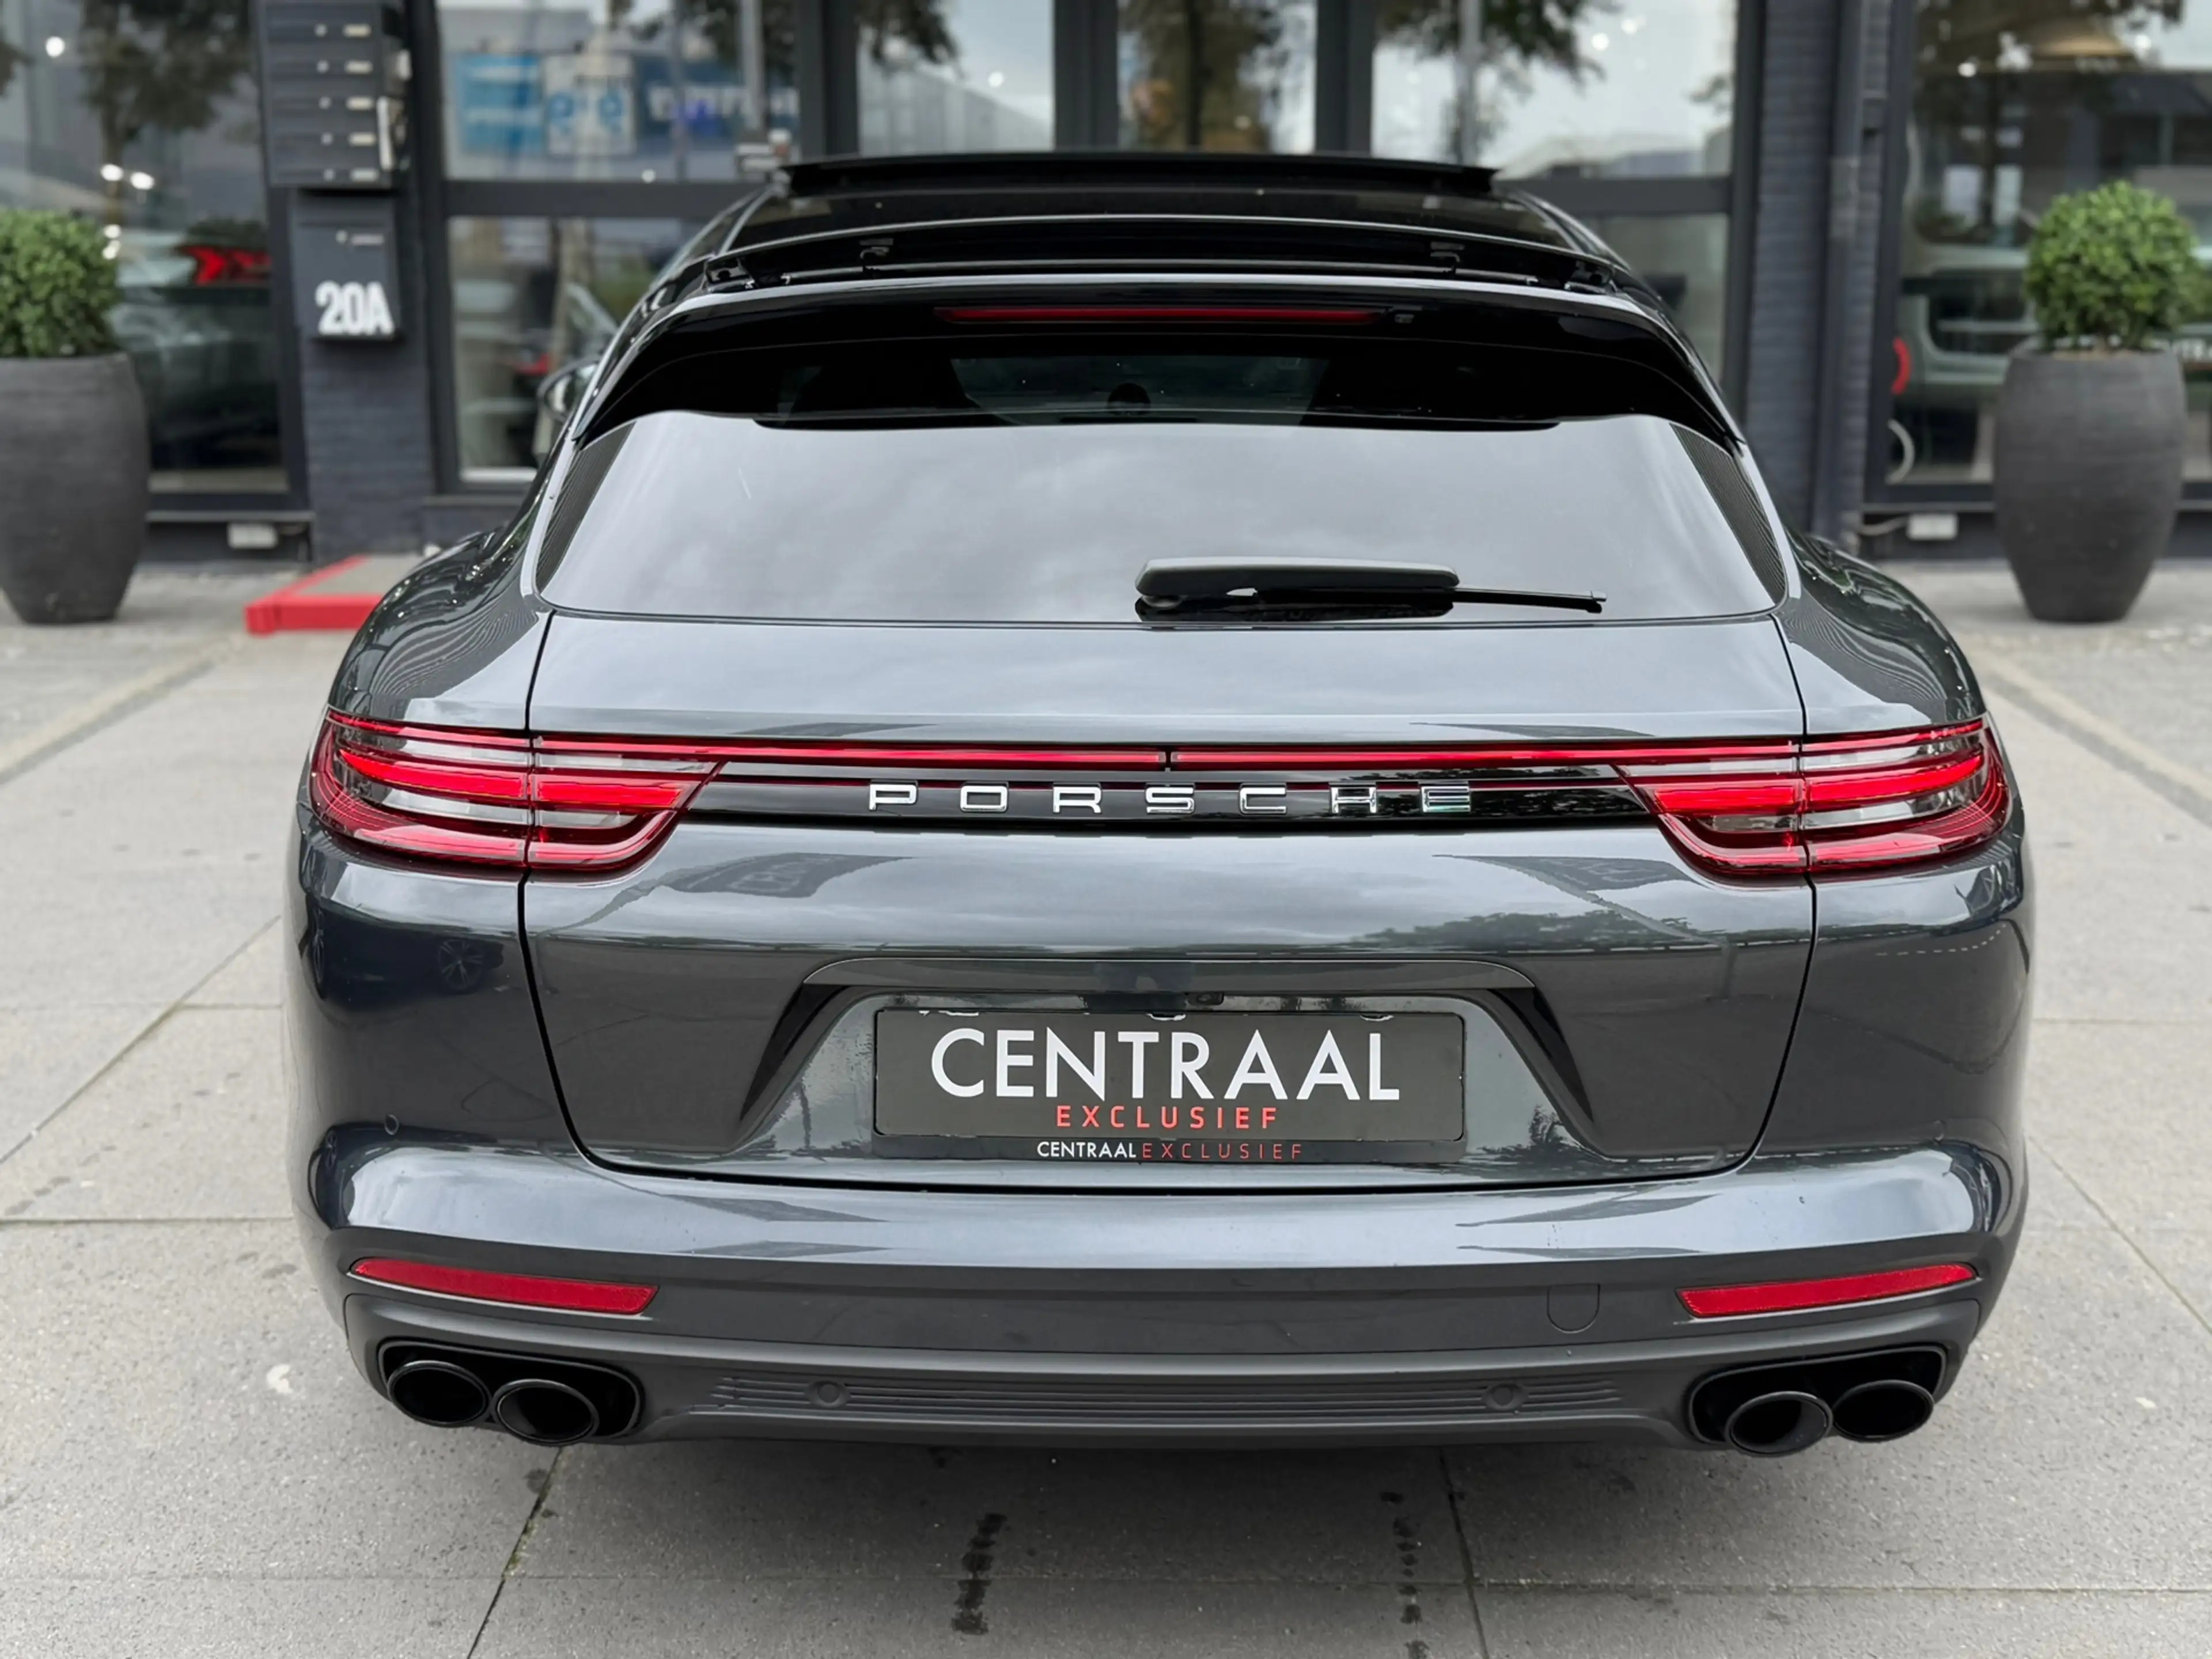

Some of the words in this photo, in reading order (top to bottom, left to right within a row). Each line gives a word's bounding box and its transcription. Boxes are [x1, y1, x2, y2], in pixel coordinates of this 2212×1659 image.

[315, 281, 394, 335] 20A
[869, 782, 1471, 815] PORSCHE
[931, 1027, 1399, 1101] CENTRAAL
[1056, 1105, 1277, 1130] EXCLUSIEF
